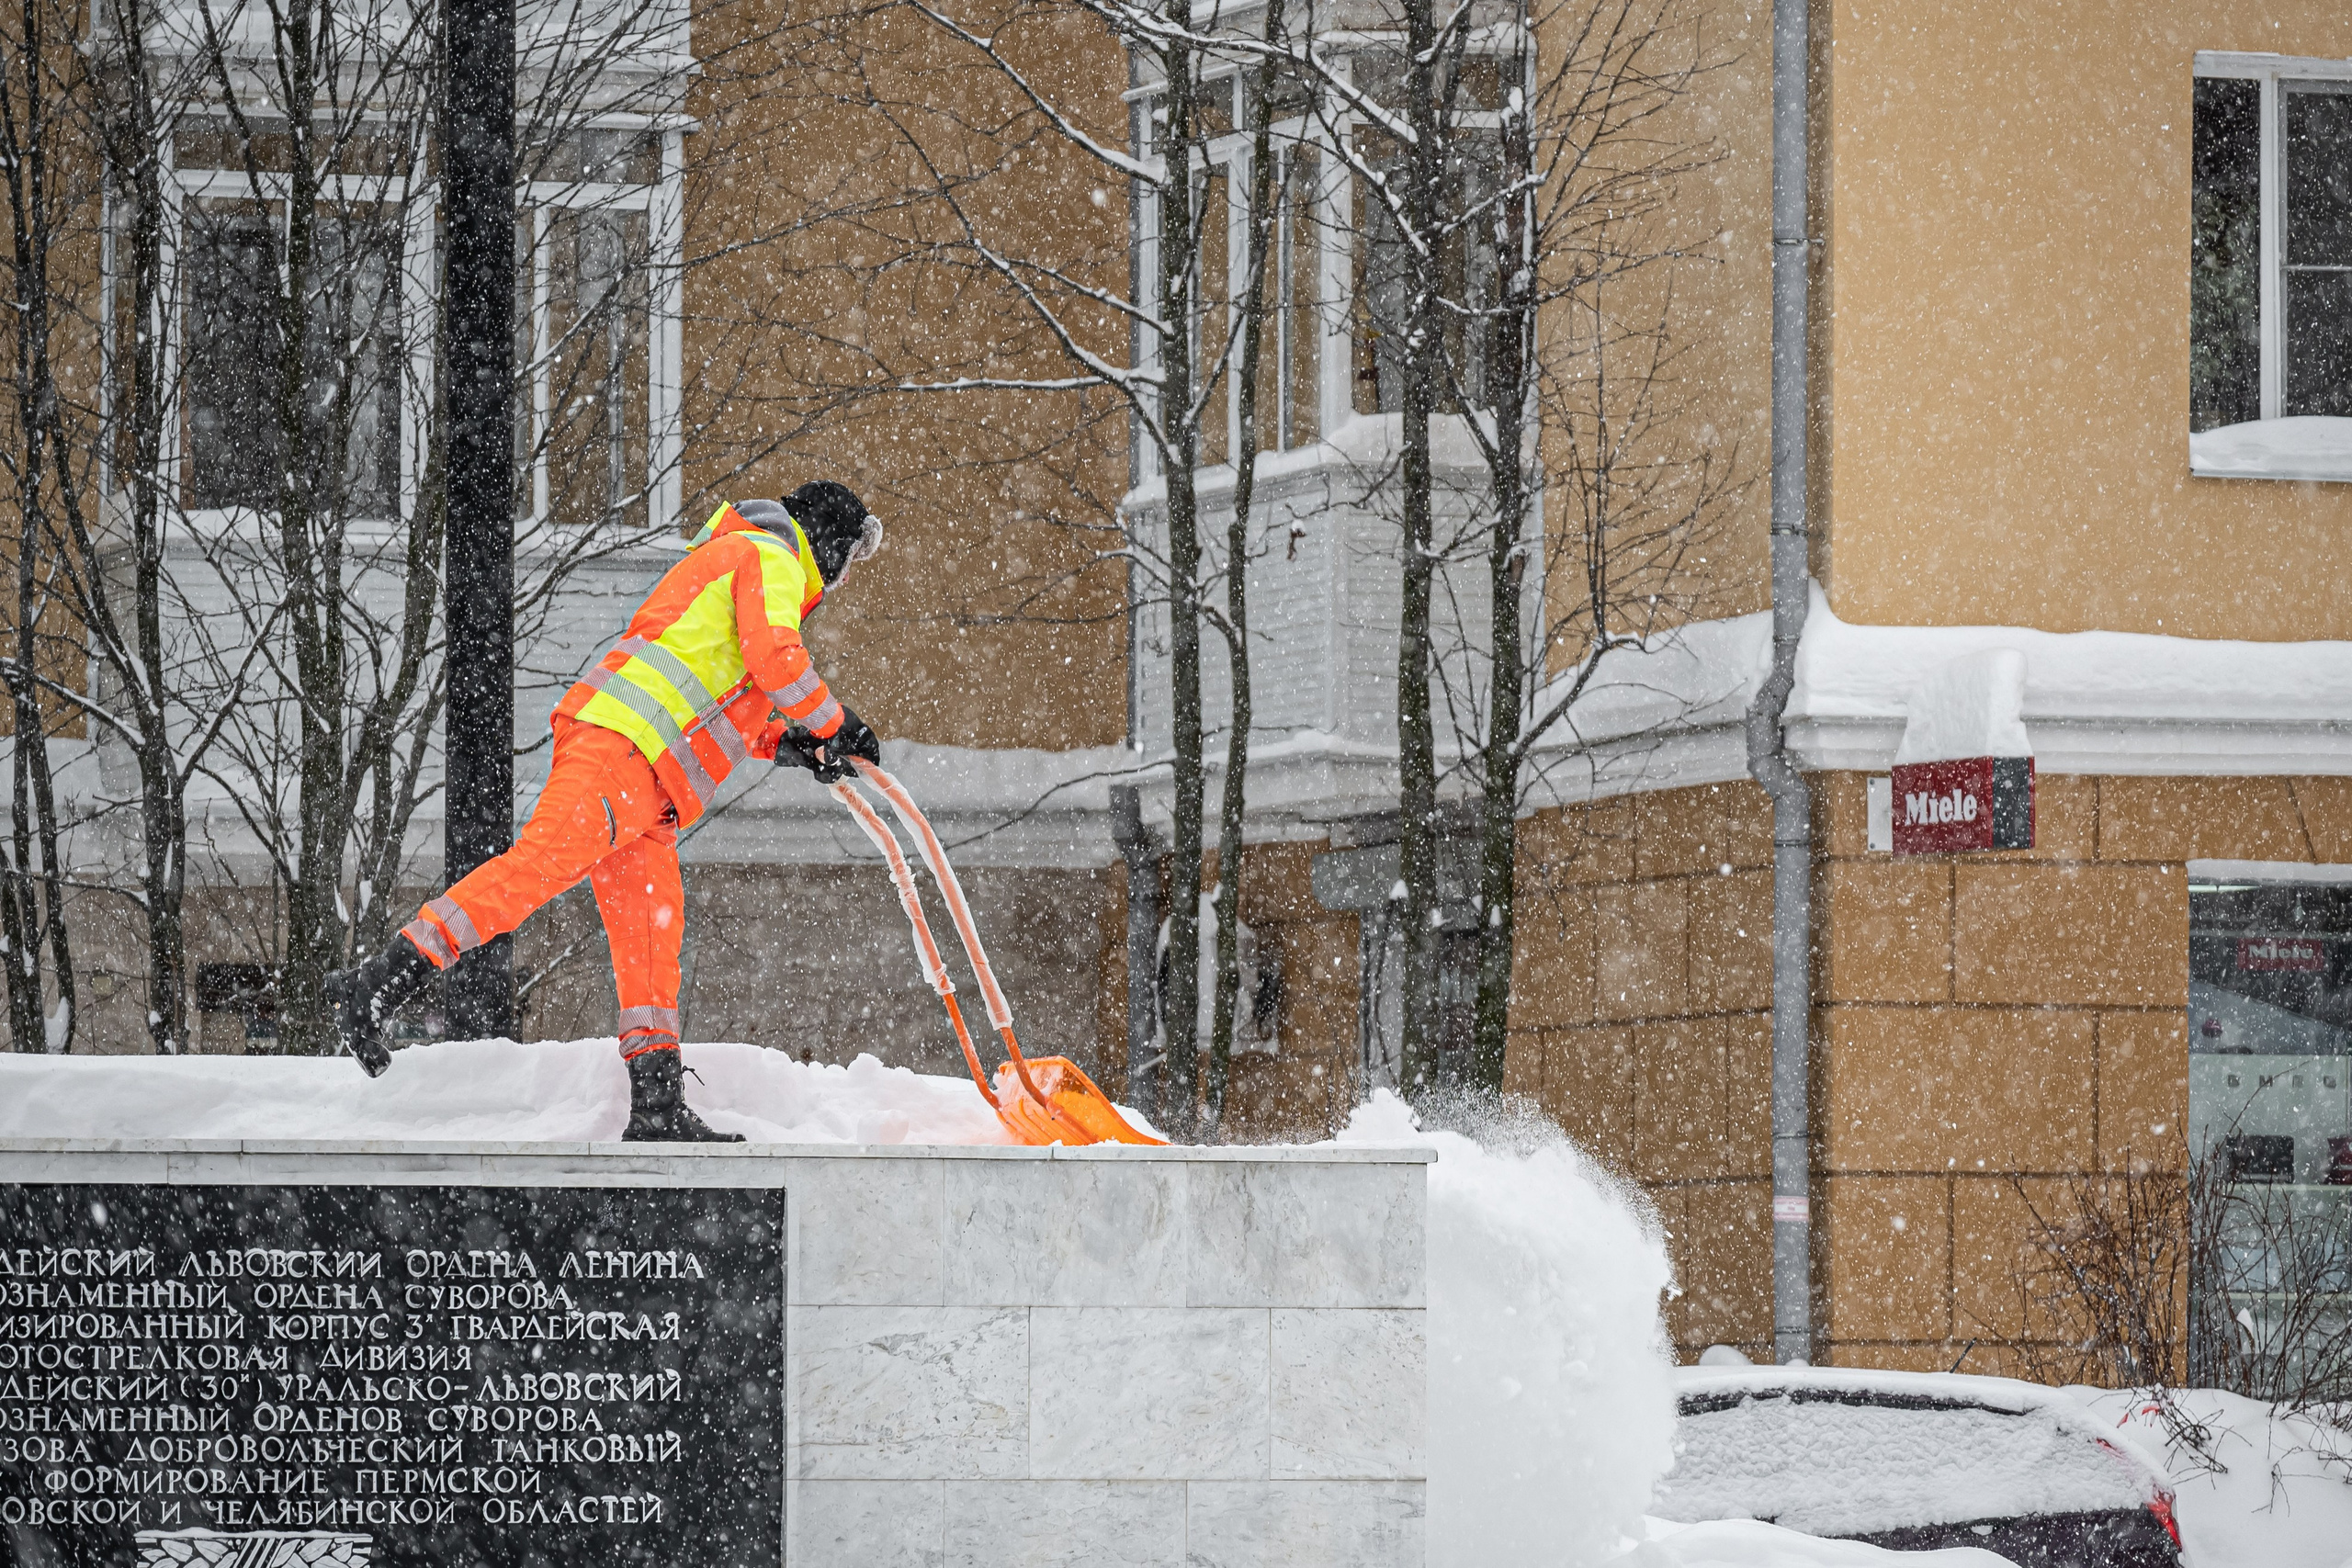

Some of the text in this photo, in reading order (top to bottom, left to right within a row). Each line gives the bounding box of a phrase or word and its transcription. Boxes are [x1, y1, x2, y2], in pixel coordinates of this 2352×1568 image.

[1905, 788, 1977, 826] Miele
[406, 1249, 537, 1279] ОРДЕНА
[559, 1250, 705, 1279] ЛЕНИНА
[254, 1283, 384, 1309] ОРДЕНА
[405, 1280, 573, 1310] СУВОРОВА
[268, 1313, 390, 1339] КОРПУС
[451, 1311, 680, 1340] ГВАРДЕЙСКАЯ
[0, 1343, 471, 1371] ОТОСТРЕЛКОВАЯ ДИВИЗИЯ
[253, 1402, 402, 1433] ОРДЕНОВ
[427, 1405, 603, 1432] СУВОРОВА
[125, 1435, 462, 1463] ДОБРОВОЛЬЧЕСКИЙ
[492, 1430, 682, 1462] ТАНКОВЫЙ
[356, 1465, 541, 1494] ПЕРМСКОЙ
[160, 1500, 181, 1525] И
[205, 1496, 456, 1525] ЧЕЛЯБИНСКОЙ
[482, 1492, 662, 1524] ОБЛАСТЕЙ
